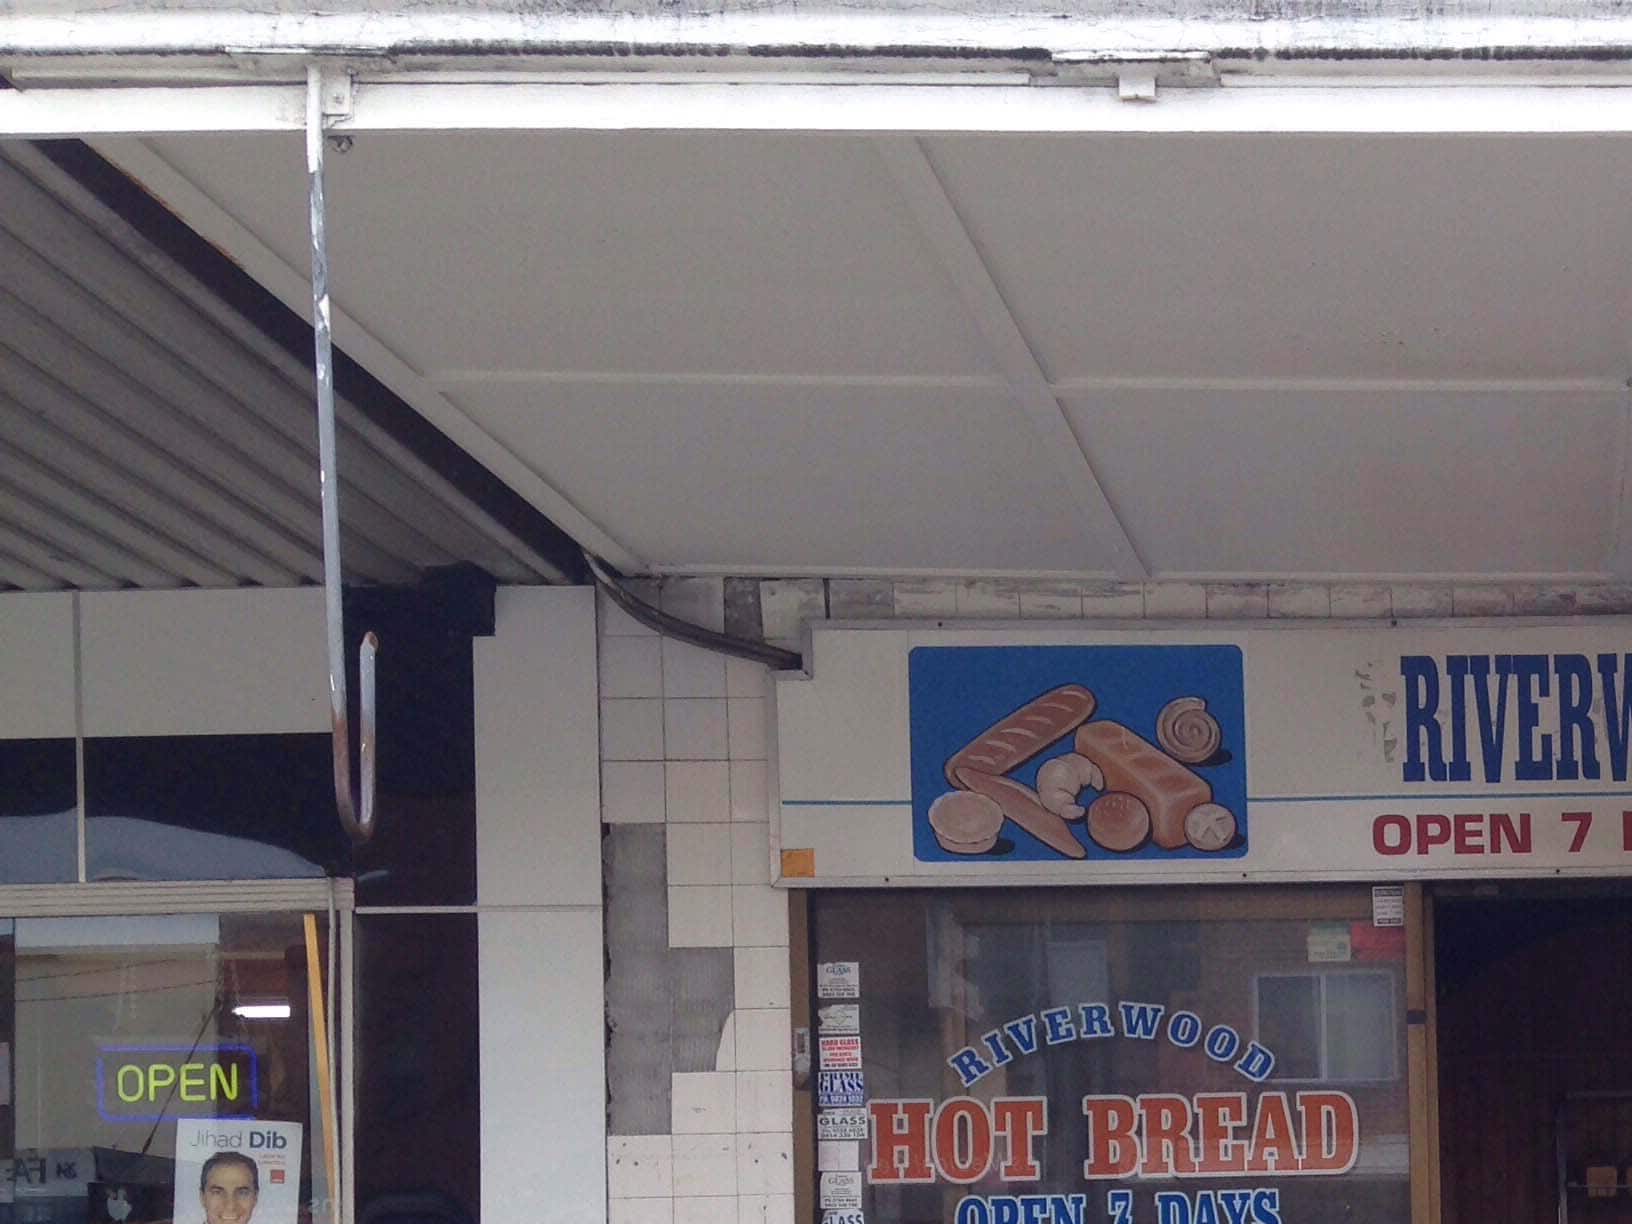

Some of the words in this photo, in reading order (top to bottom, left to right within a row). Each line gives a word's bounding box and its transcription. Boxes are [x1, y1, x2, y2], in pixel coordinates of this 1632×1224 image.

[1372, 812, 1532, 855] OPEN
[1560, 811, 1593, 853] 7
[948, 1001, 1276, 1087] RIVERWOOD
[117, 1062, 239, 1103] OPEN
[190, 1129, 243, 1149] Jihad
[249, 1130, 287, 1150] Dib
[819, 1116, 866, 1126] GLASS
[867, 1095, 1047, 1184] HOT
[1084, 1091, 1360, 1180] BREAD
